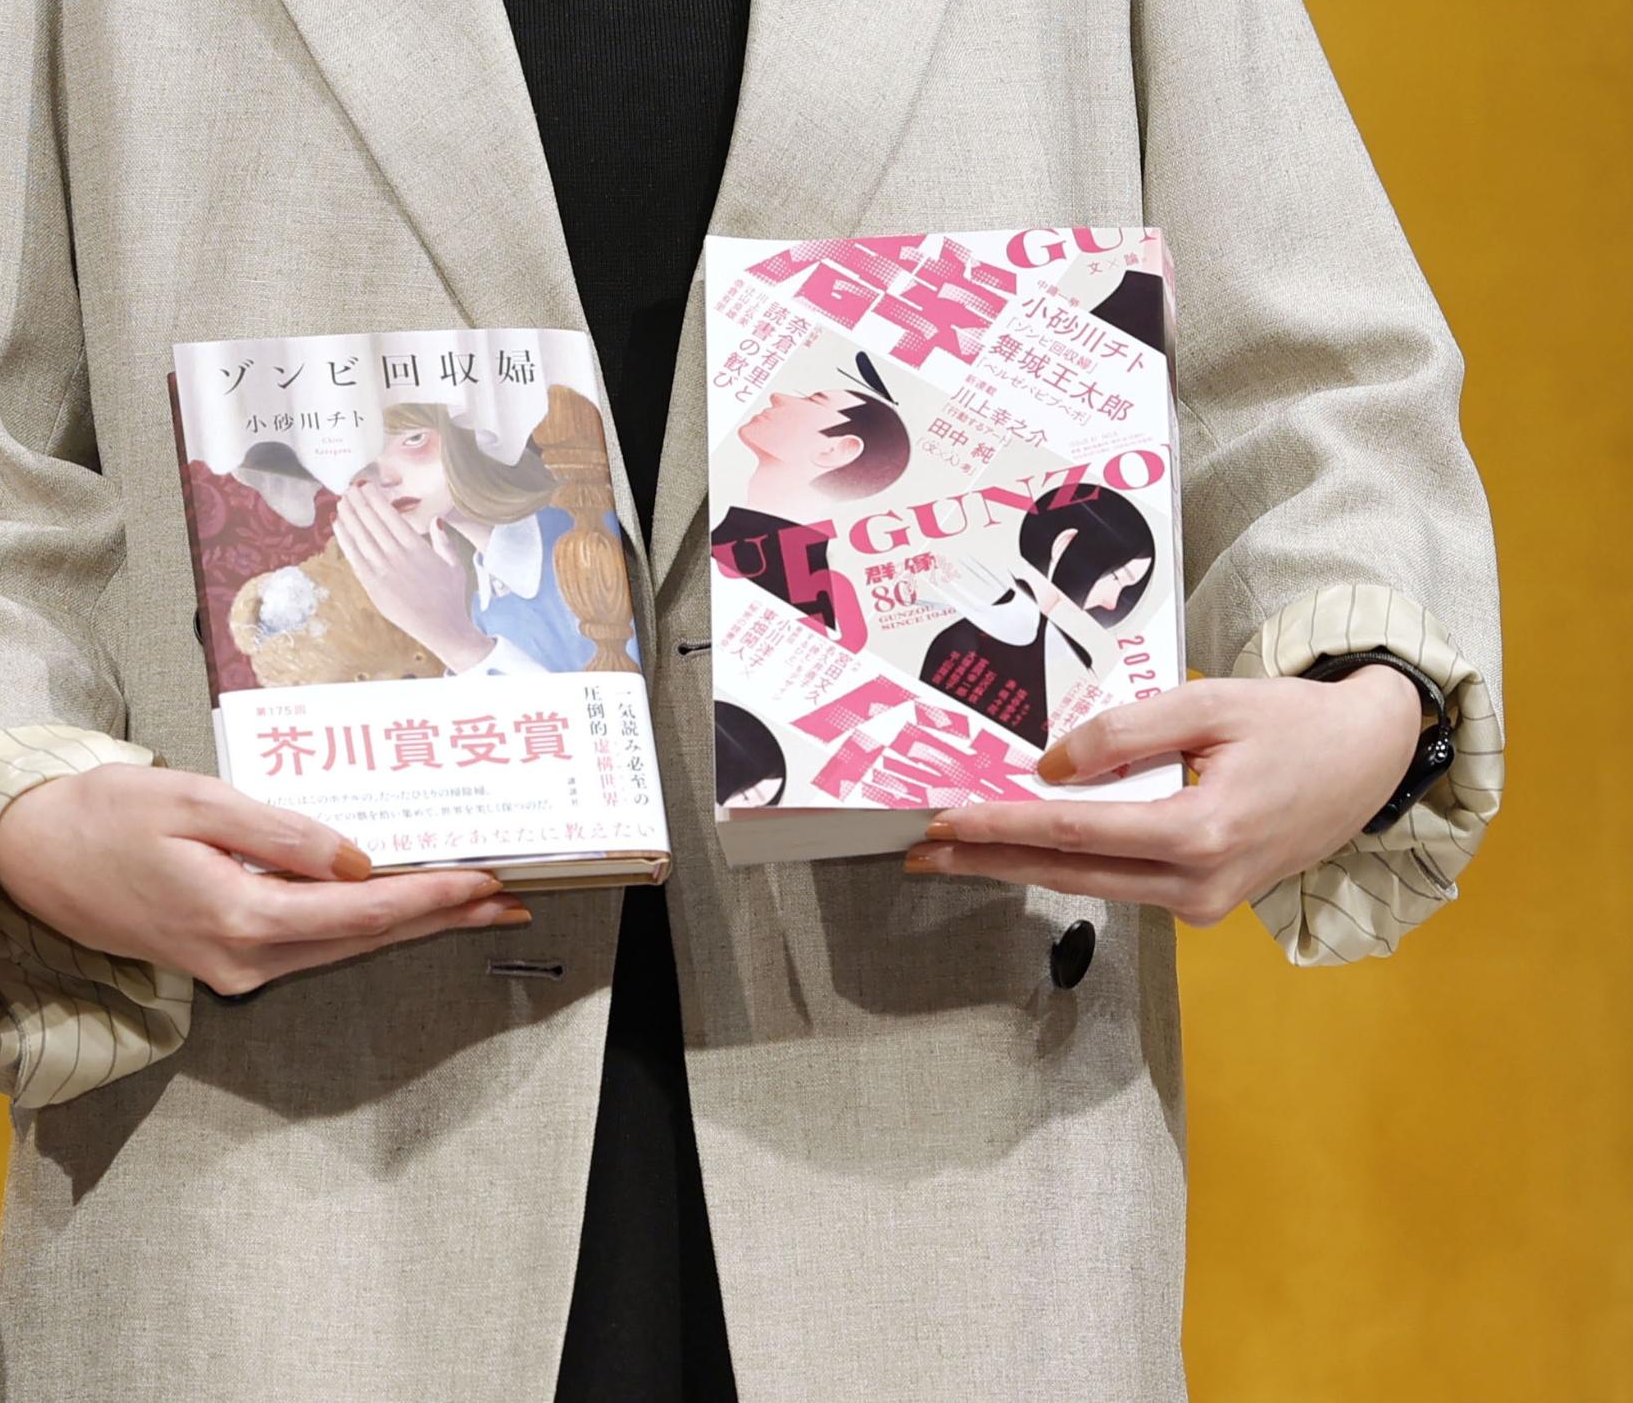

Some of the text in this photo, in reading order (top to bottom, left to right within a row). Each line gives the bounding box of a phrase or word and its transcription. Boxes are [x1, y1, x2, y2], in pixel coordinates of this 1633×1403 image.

[713, 300, 792, 389] 読書の歓び
[734, 315, 813, 403] 奈倉有里と
[1005, 315, 1099, 375] 「ゾンビ回収婦」
[1021, 296, 1145, 373] 小砂川チト
[220, 349, 537, 395] ゾンビ回収婦
[987, 333, 1135, 422] 舞城王太郎
[246, 409, 366, 434] 小砂川チト
[927, 417, 997, 465] 田中 純
[950, 386, 1048, 448] 川上幸之介
[849, 447, 1170, 555] GUNZO
[778, 519, 868, 655] 5
[865, 551, 938, 585] 群像
[871, 580, 917, 613] 80
[729, 607, 779, 661] 東畑開人
[927, 606, 957, 621] 1946
[1117, 636, 1161, 700] 2026
[256, 703, 307, 717] 第175回
[257, 711, 573, 777] 芥川賞受賞
[615, 690, 649, 805] 一気読み必至の
[353, 821, 656, 853] の秘密をあなたに教えたい
